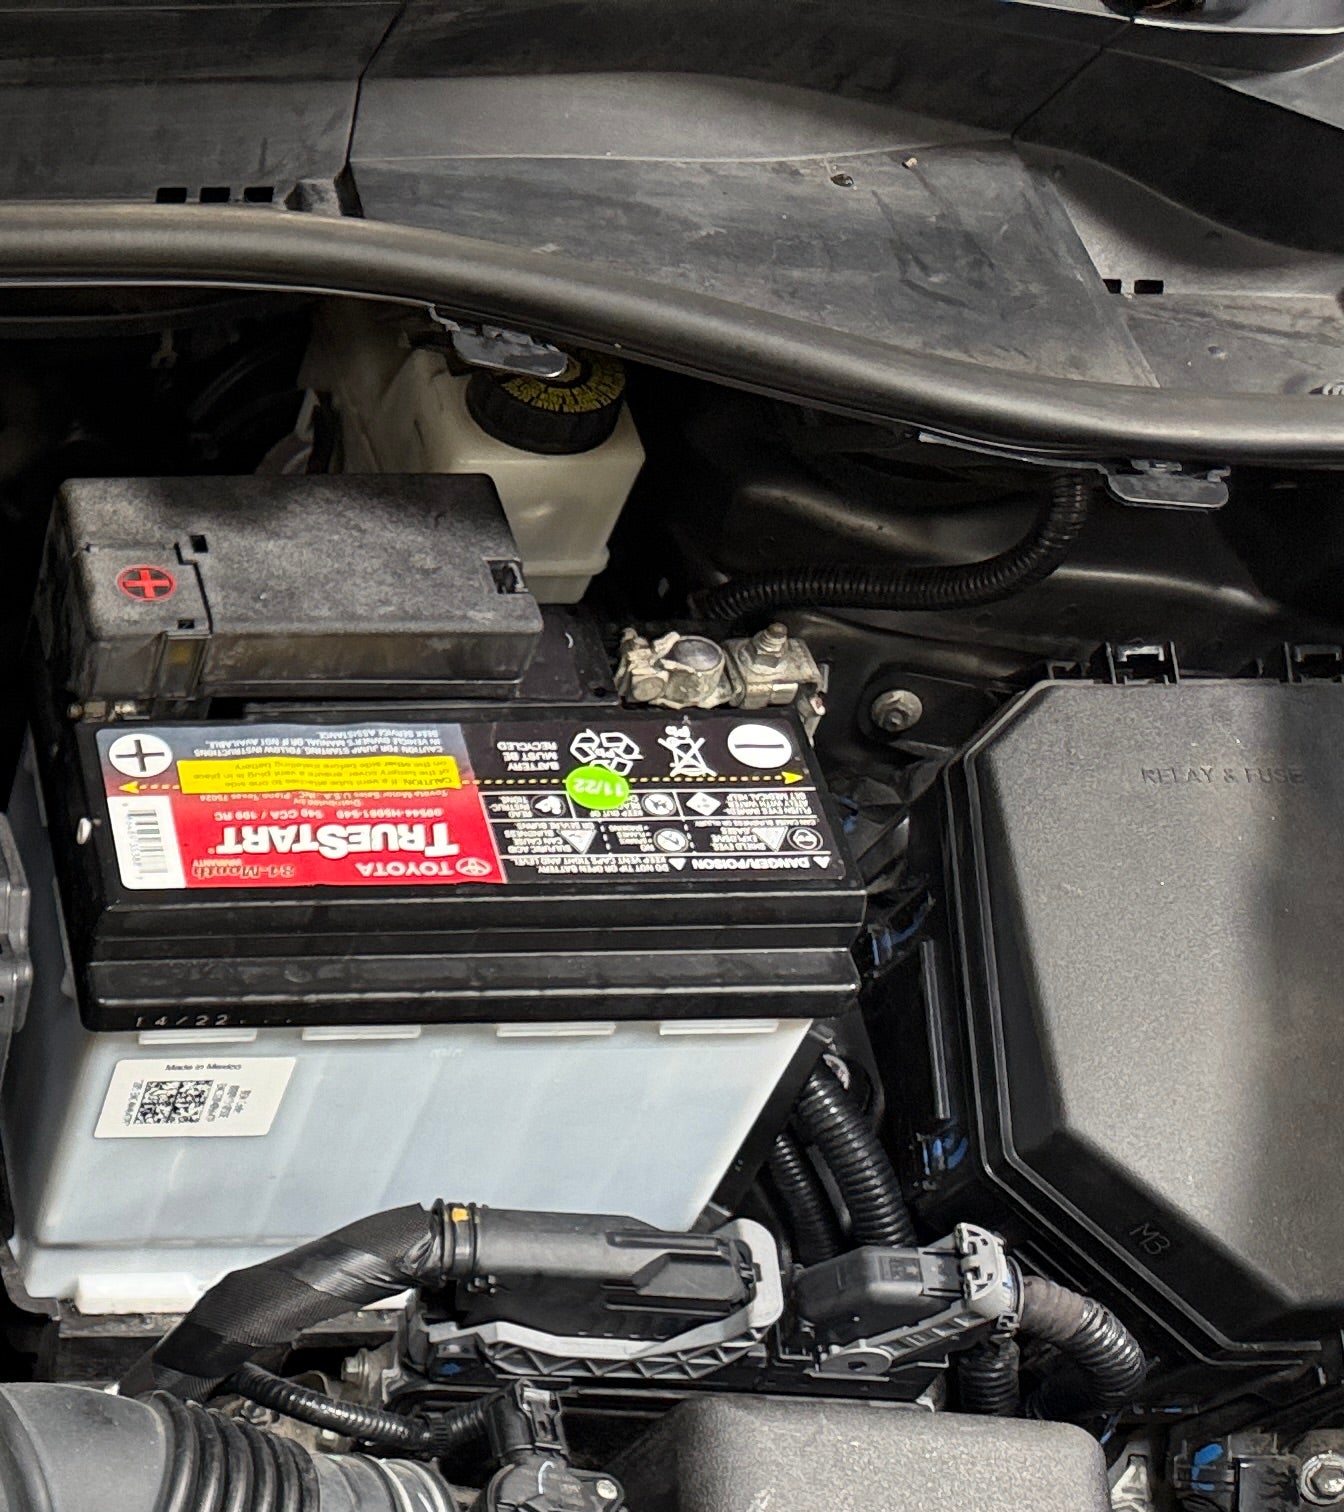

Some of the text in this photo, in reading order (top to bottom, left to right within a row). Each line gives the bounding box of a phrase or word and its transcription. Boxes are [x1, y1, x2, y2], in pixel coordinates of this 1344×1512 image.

[496, 741, 558, 750] RECYCLED
[501, 751, 558, 761] MUST BE
[506, 761, 560, 770] BATTERY
[1140, 765, 1213, 784] RELAY
[1243, 766, 1306, 785] FUSE
[573, 779, 621, 797] 11/22
[354, 860, 455, 877] TOYOTA
[691, 856, 810, 869] DANGER/POISON
